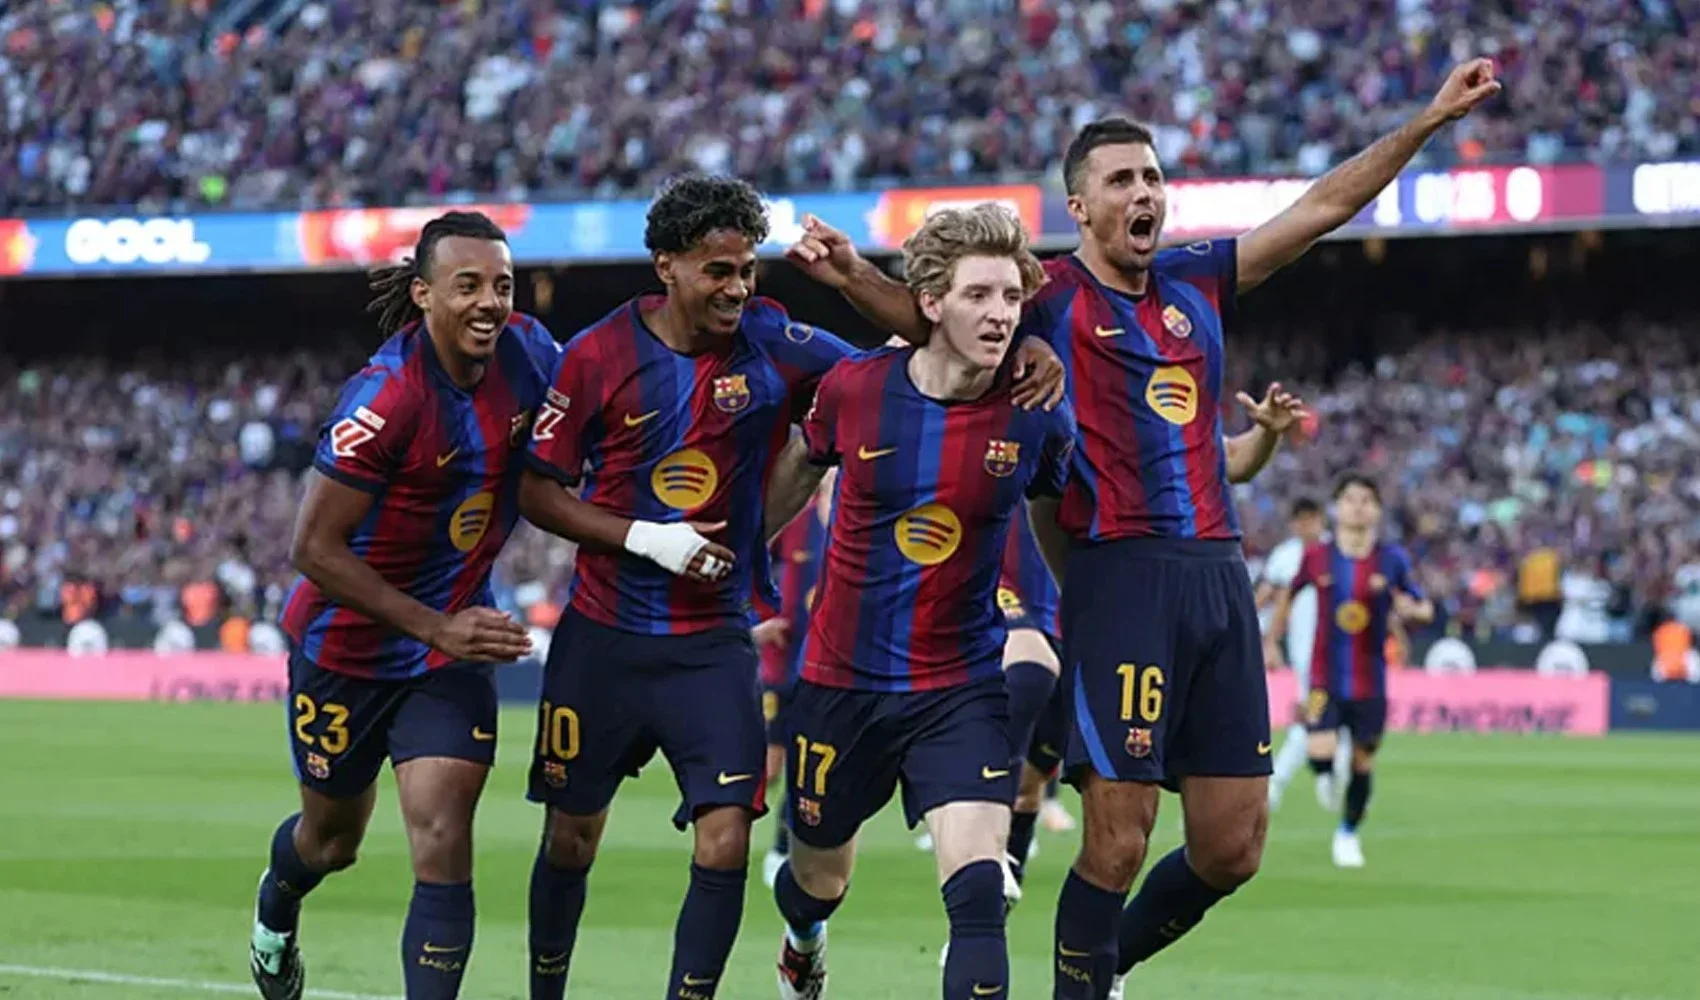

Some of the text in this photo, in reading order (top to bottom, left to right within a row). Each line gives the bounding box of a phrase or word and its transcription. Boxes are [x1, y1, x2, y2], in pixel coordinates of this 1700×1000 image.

[1116, 663, 1165, 722] 16
[295, 693, 349, 754] 23
[540, 701, 580, 760] 10
[796, 735, 836, 796] 17
